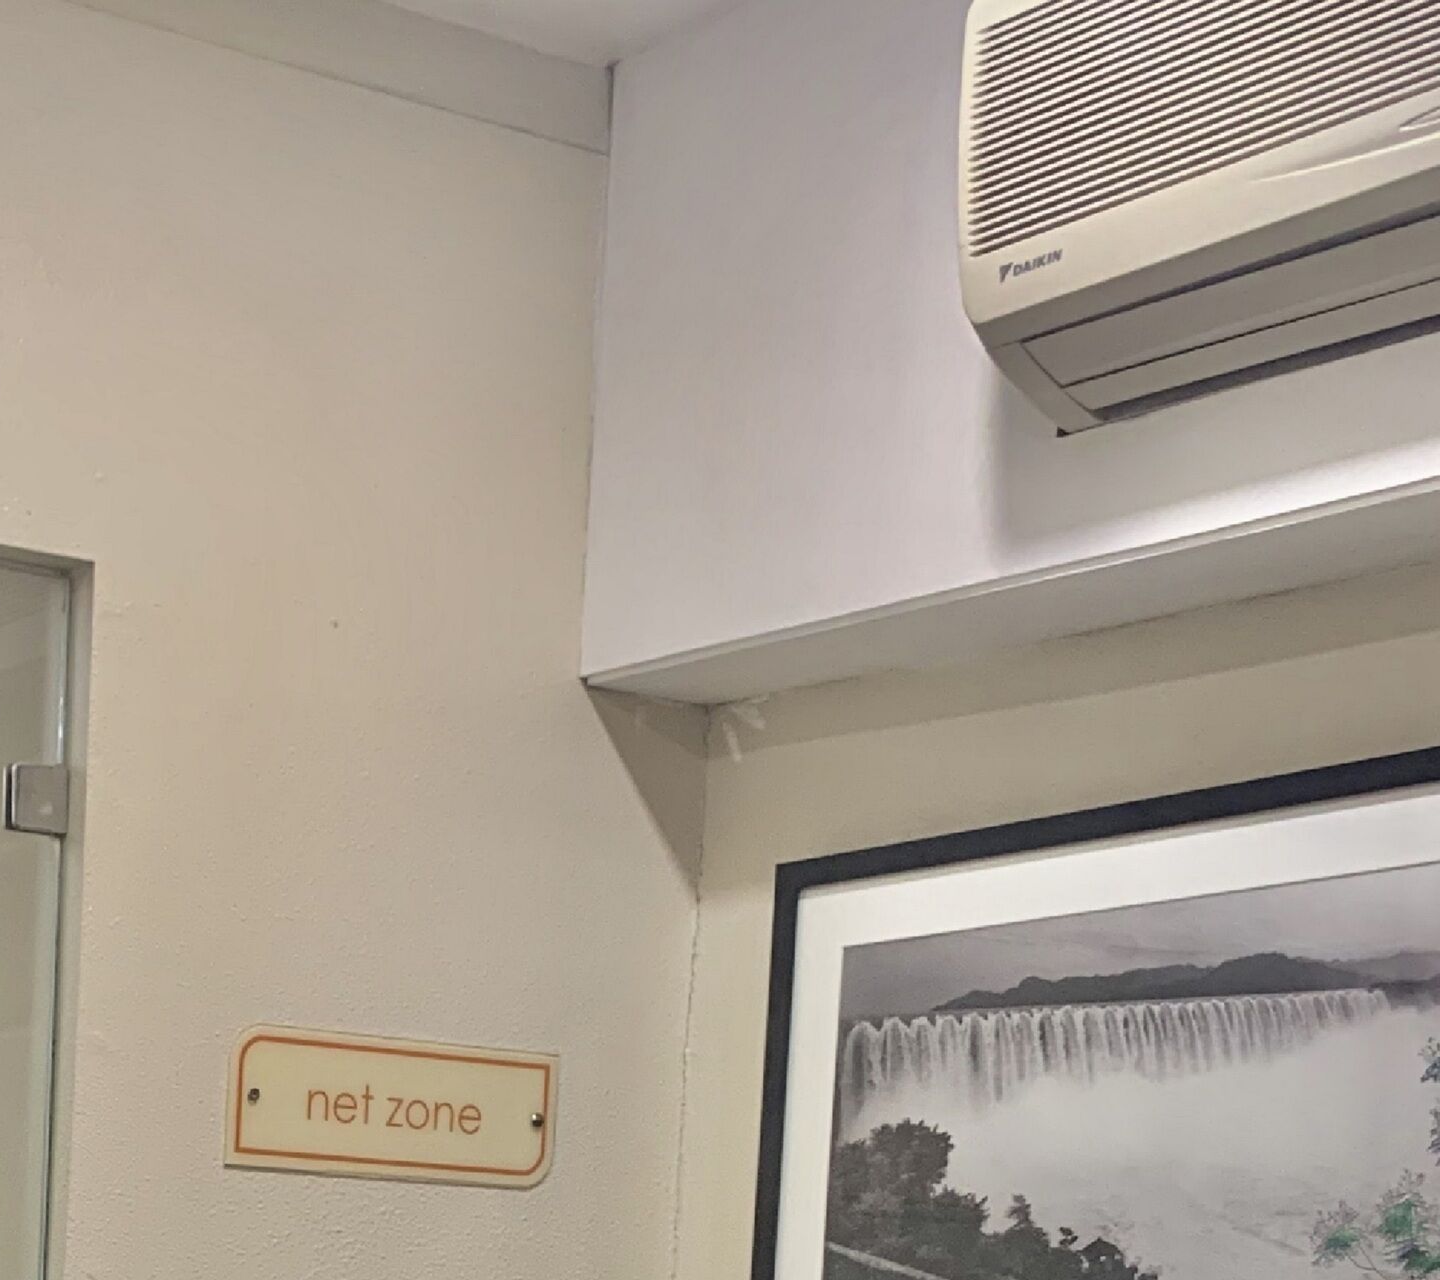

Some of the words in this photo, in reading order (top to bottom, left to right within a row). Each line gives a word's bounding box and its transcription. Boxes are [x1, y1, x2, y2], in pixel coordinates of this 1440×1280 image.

[1012, 249, 1064, 277] DAIKIN
[306, 1084, 375, 1126] net
[385, 1096, 483, 1136] zone
